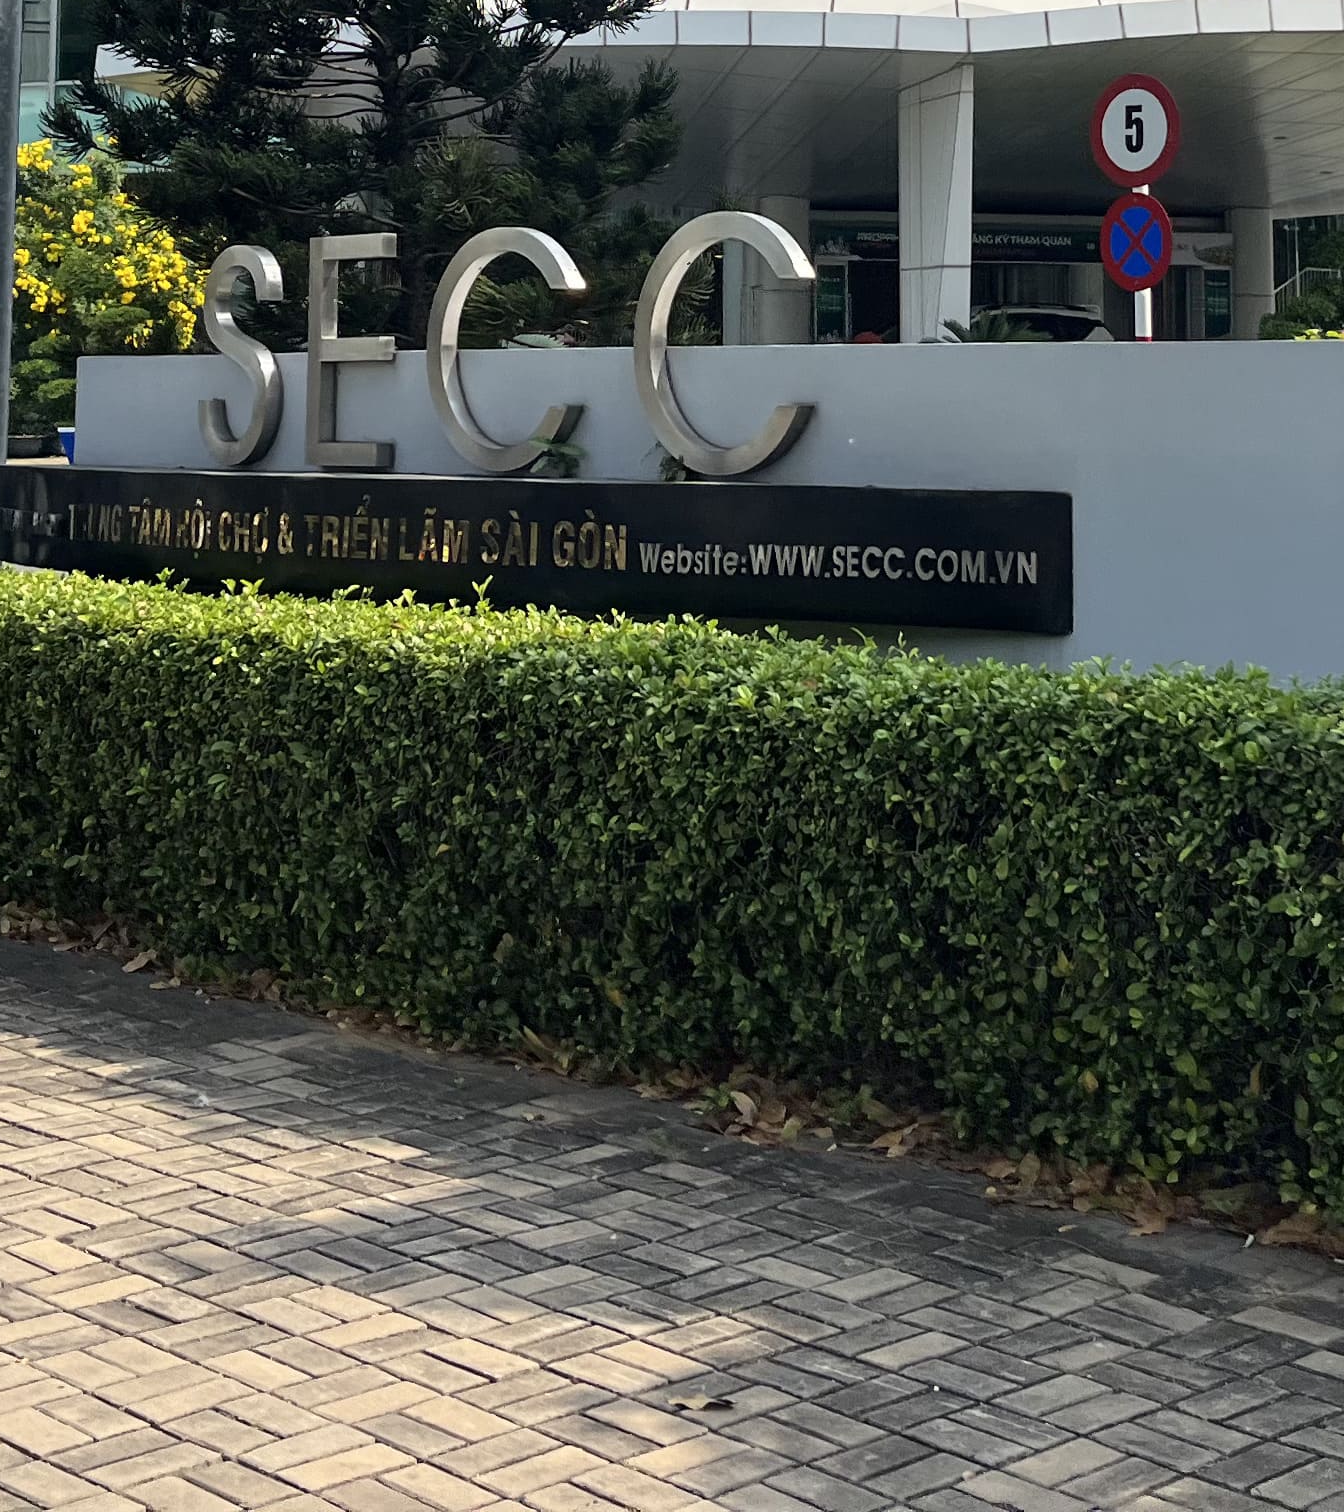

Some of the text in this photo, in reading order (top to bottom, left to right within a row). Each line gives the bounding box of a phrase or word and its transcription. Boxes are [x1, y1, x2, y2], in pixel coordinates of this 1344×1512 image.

[1125, 104, 1144, 153] 5
[197, 211, 816, 475] SECC
[277, 513, 295, 554] &
[399, 507, 469, 564] LÃM
[481, 509, 538, 567] SÀI
[552, 508, 628, 572] GÒN
